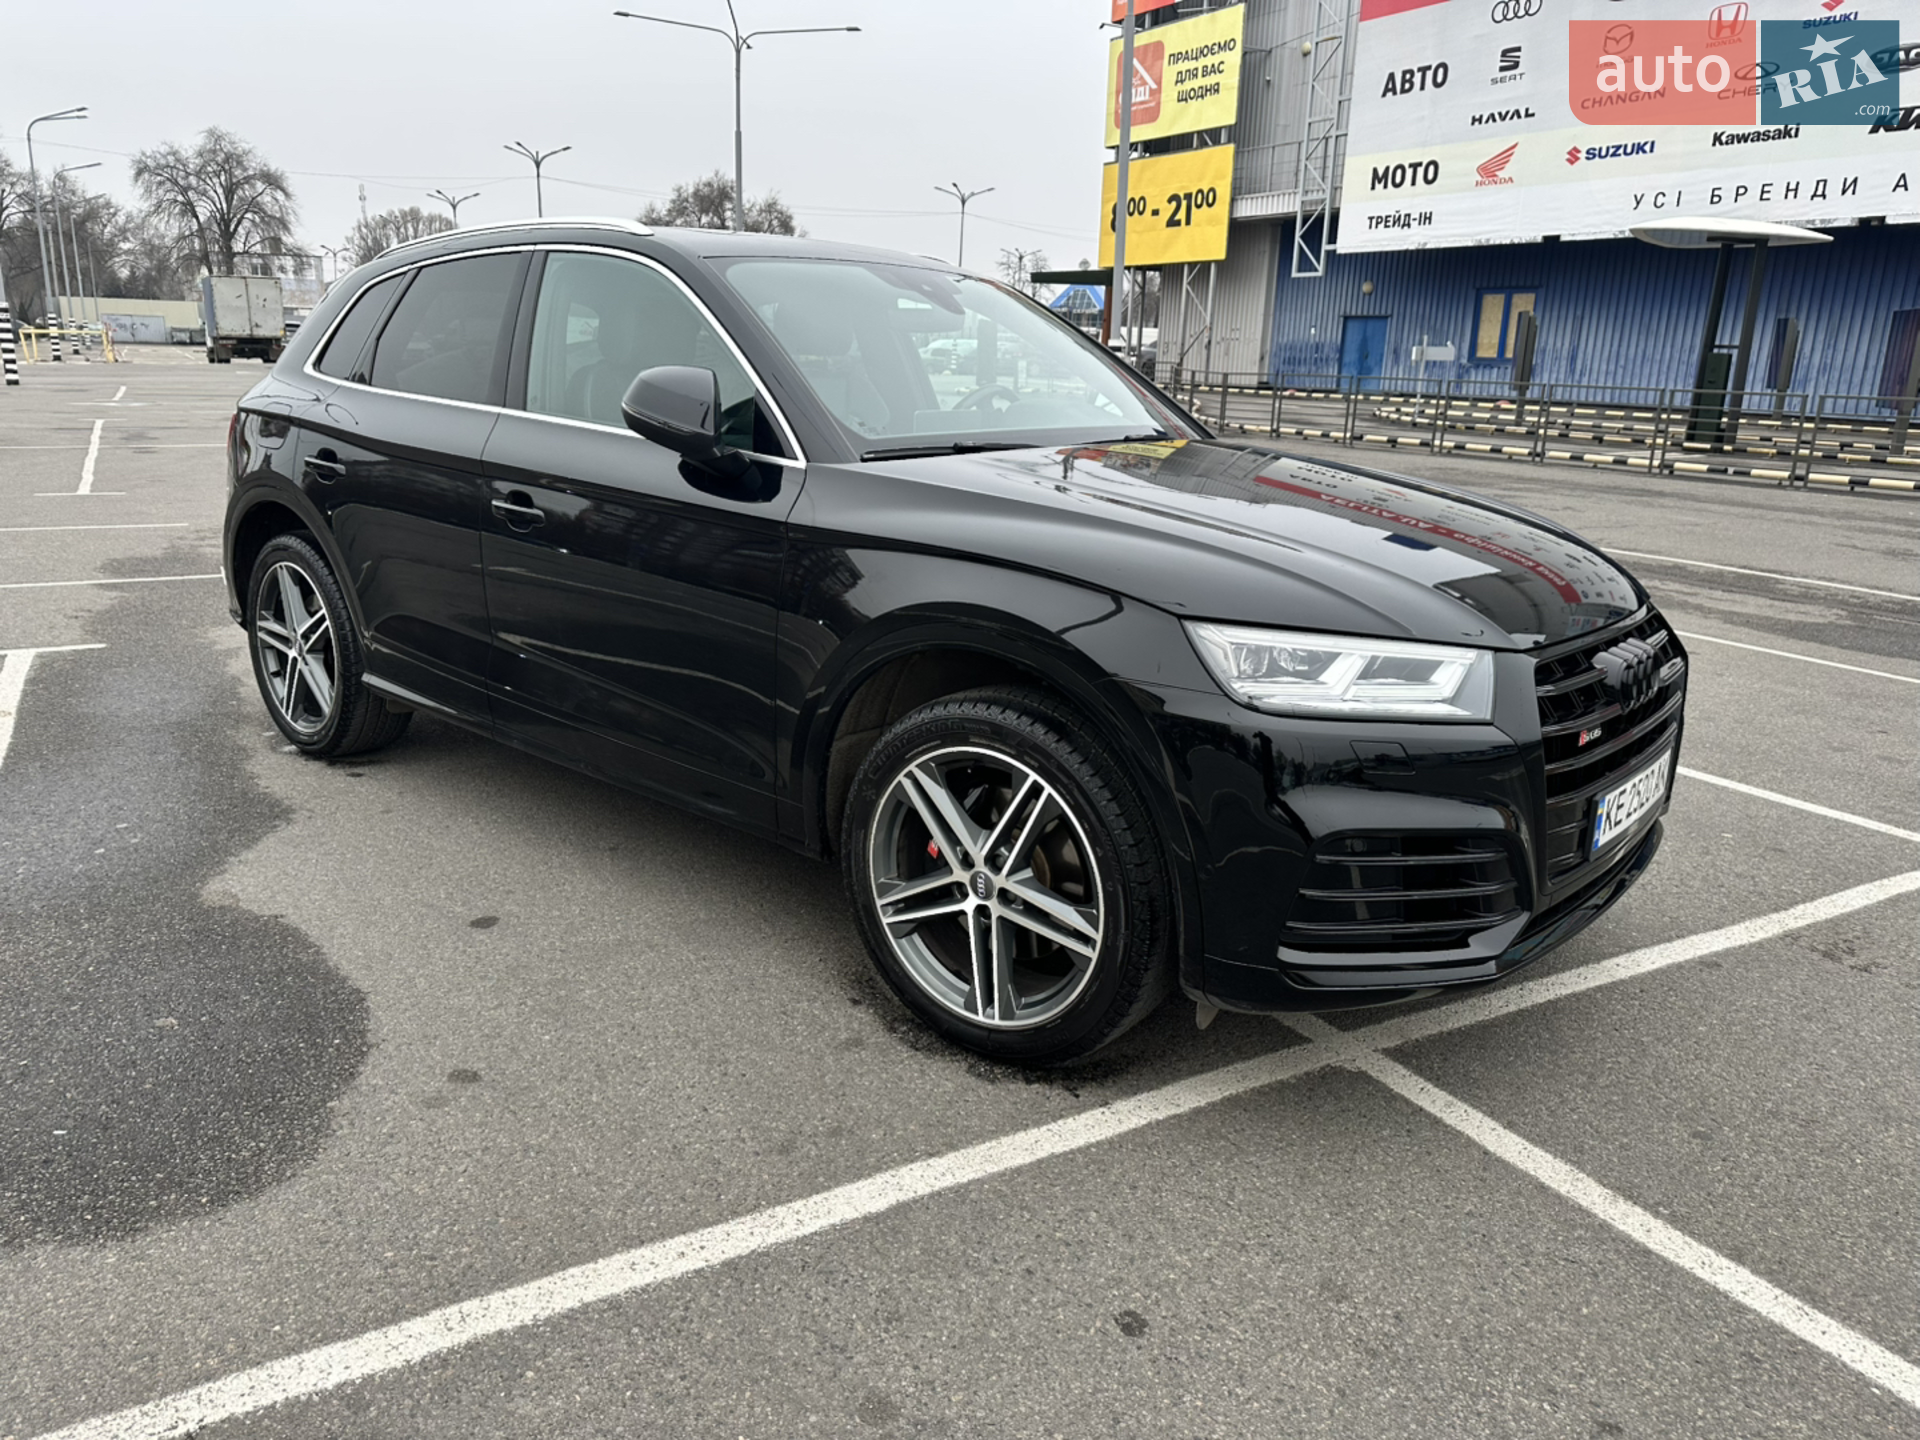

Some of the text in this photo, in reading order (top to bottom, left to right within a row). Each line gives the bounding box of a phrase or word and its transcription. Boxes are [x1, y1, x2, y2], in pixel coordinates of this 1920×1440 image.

[1802, 11, 1858, 29] SUZUKI
[1168, 38, 1237, 66] ПРАЦЮЄМО
[1705, 37, 1743, 49] HONDA
[1174, 60, 1225, 86] ДЛЯ ВАС
[1381, 62, 1449, 98] АВТО
[1490, 72, 1526, 86] SEAT
[1176, 82, 1220, 104] ЩОДНЯ
[1580, 87, 1666, 110] CHANGAN
[1471, 107, 1536, 126] HAVAL
[1711, 123, 1800, 147] Kawasaki
[1584, 140, 1656, 161] SUZUKI
[1370, 159, 1440, 191] МОТО
[1474, 176, 1515, 188] HONDA
[1632, 190, 1683, 211] УСІ
[1709, 176, 1859, 206] БРЕНДИ
[1367, 210, 1433, 230] ТРЕЙД-ІН
